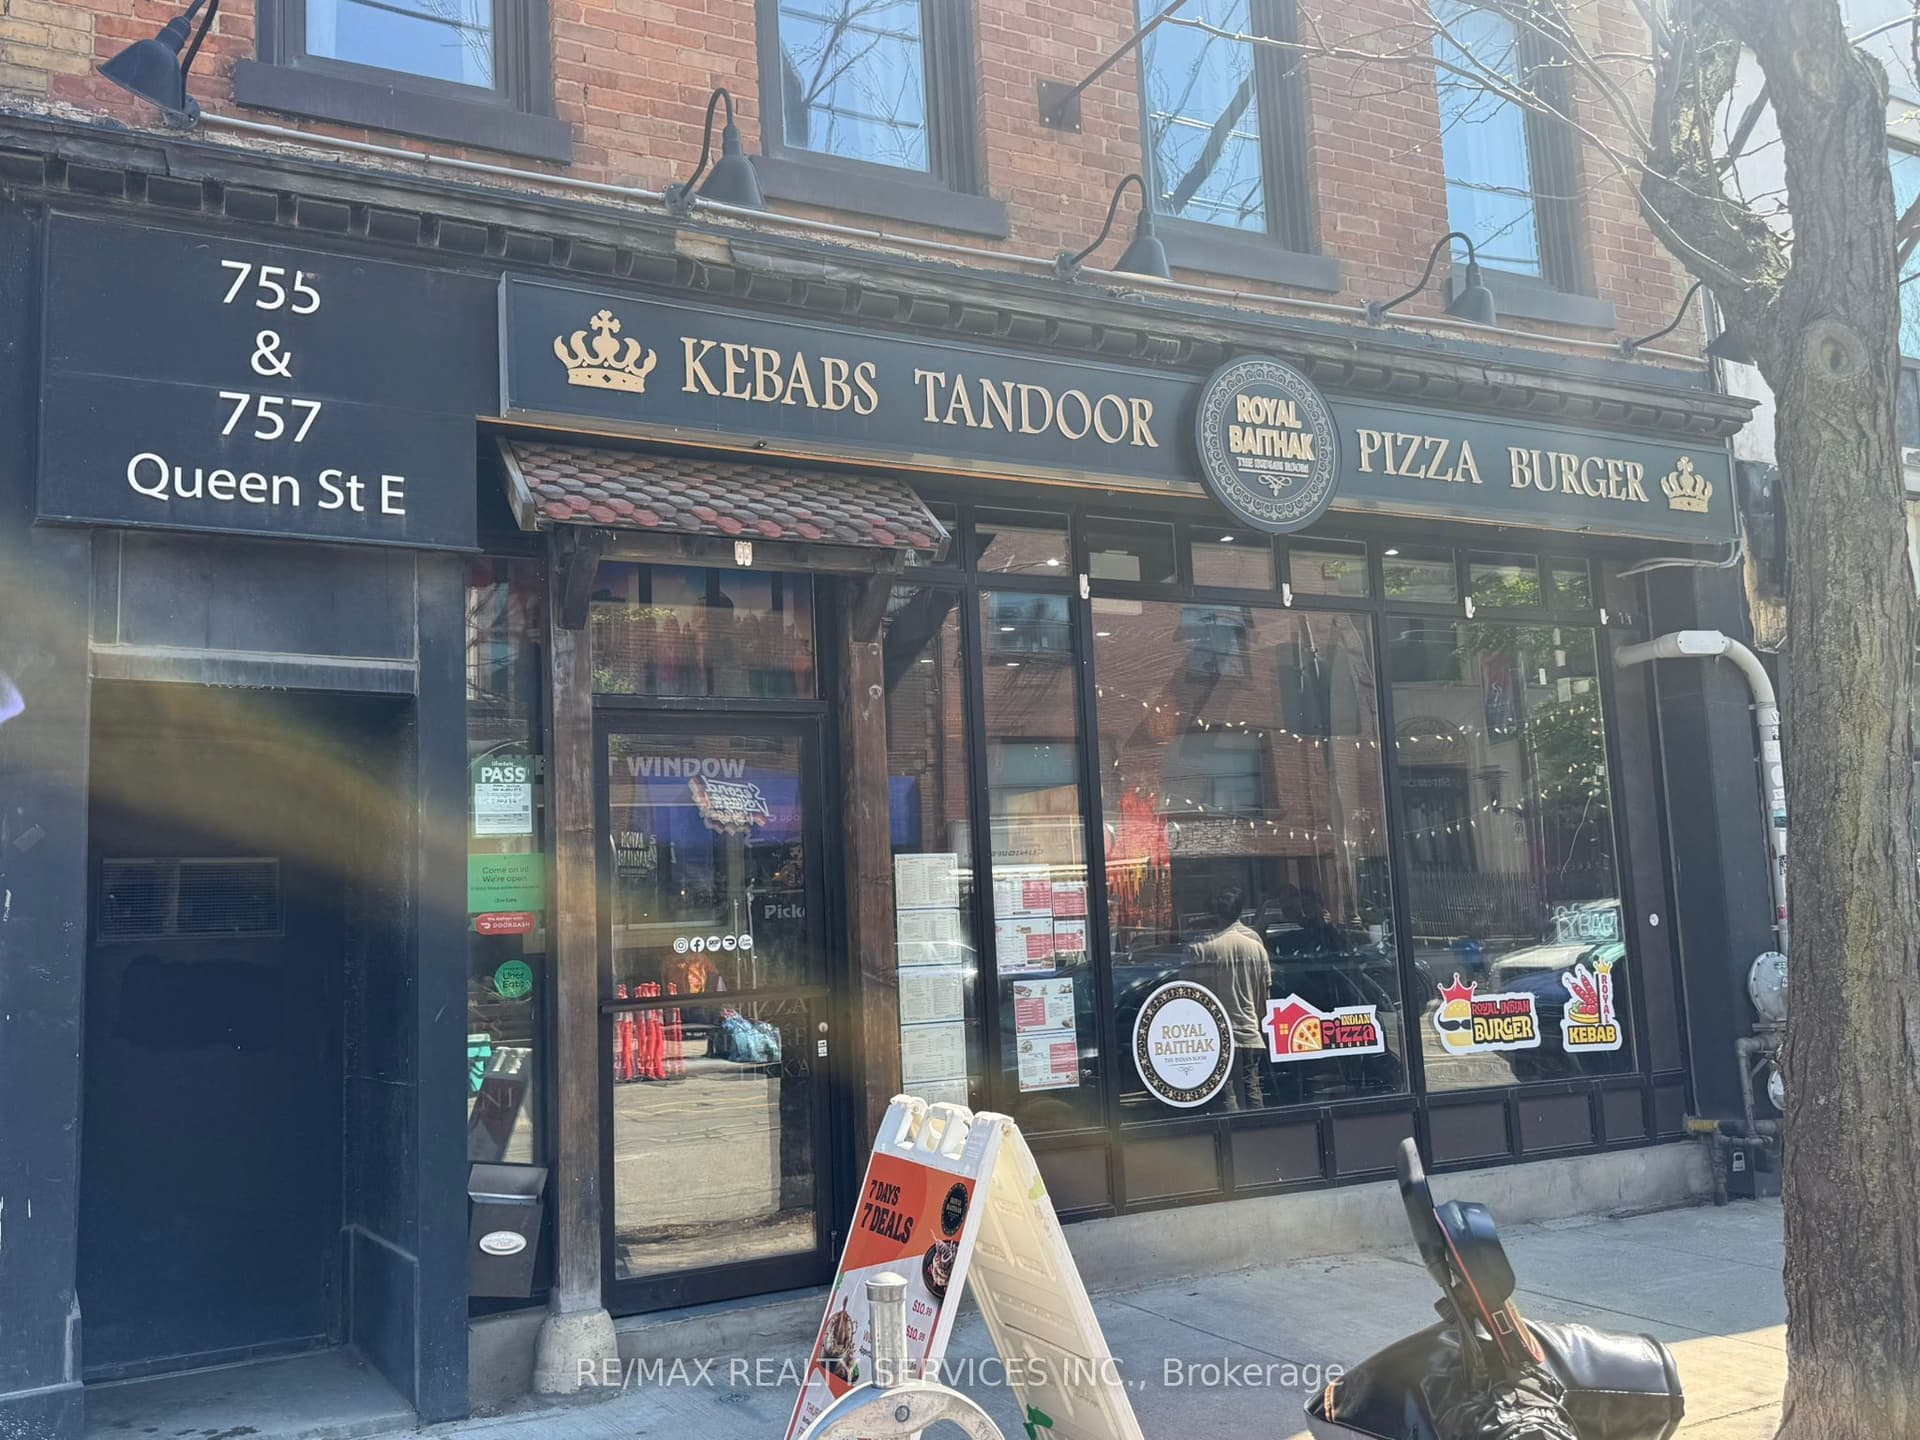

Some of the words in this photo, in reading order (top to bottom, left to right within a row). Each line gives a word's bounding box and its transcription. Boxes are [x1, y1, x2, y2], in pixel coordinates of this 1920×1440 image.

[220, 258, 321, 314] 755
[250, 329, 292, 377] &
[680, 336, 879, 416] KEBABS
[914, 368, 1159, 448] TANDOOR
[217, 390, 322, 443] 757
[1236, 394, 1303, 429] ROYAL
[1229, 424, 1316, 461] BAITHAK
[1355, 428, 1483, 485] PIZZA
[1507, 446, 1650, 503] BURGER
[126, 452, 301, 507] Queen
[317, 468, 366, 513] St
[380, 474, 406, 516] E
[481, 766, 526, 783] PASS
[627, 756, 746, 778] WINDOW
[482, 866, 507, 874] Come
[506, 876, 528, 884] open
[1471, 1001, 1499, 1016] ROYAL
[1499, 999, 1531, 1015] INDIAN
[1601, 974, 1610, 1025] ROYAL
[1161, 1024, 1207, 1039] ROYAL
[1321, 1017, 1376, 1045] Pizza
[1341, 1013, 1371, 1026] INDIAN
[1473, 1015, 1534, 1043] BURGER
[1154, 1037, 1215, 1056] BAITHAK
[1568, 1025, 1617, 1045] KEBAB
[869, 1178, 879, 1199] 7
[876, 1181, 901, 1207] DAYS
[861, 1202, 874, 1228] 7
[869, 1205, 914, 1244] DEALS
[912, 1299, 933, 1317] $10.99
